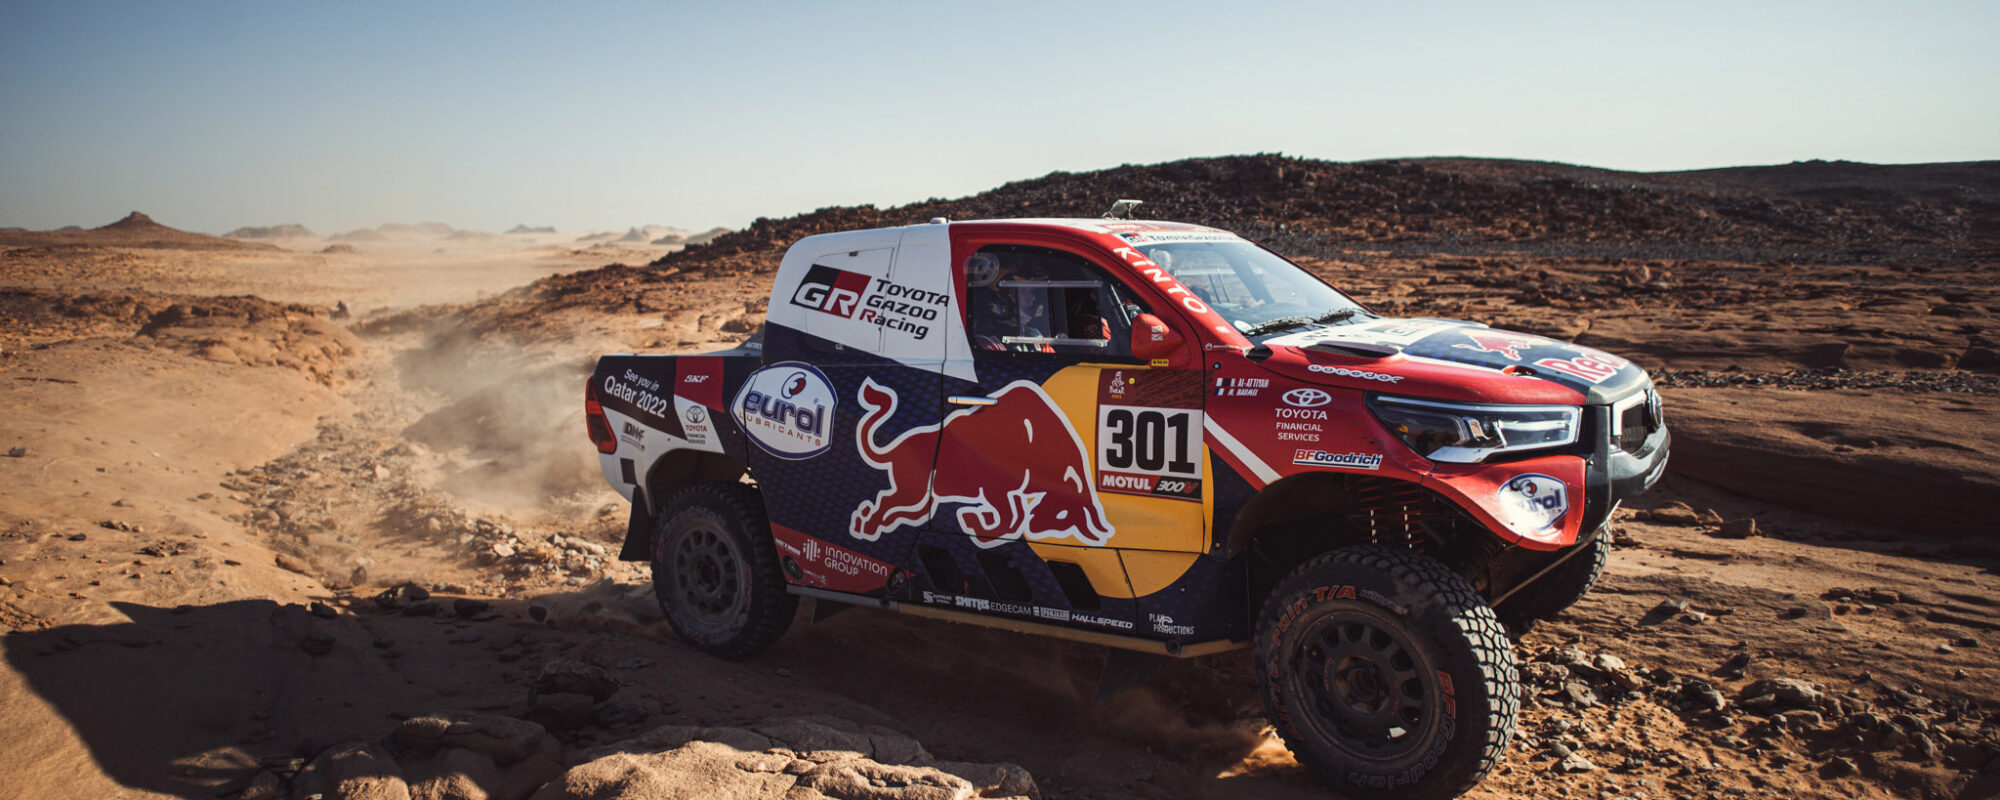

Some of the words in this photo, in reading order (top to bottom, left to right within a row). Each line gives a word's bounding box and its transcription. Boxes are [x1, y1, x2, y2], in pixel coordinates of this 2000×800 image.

[1113, 247, 1207, 313] KINTO
[794, 281, 860, 317] GR
[876, 278, 951, 307] TOYOTA
[865, 294, 938, 321] GAZOO
[858, 308, 929, 340] Racing
[623, 368, 639, 382] See
[638, 376, 650, 388] you
[650, 380, 660, 392] in
[684, 375, 709, 383] SKF
[604, 375, 637, 404] Qatar
[636, 390, 667, 418] 2022
[743, 390, 825, 438] eurol
[1275, 408, 1328, 420] TOYOTA
[686, 424, 708, 432] TOYOTA
[738, 411, 822, 447] LUBRICANTS
[1276, 422, 1323, 432] FINANCIAL
[1277, 432, 1320, 442] SERVICES
[1106, 409, 1195, 474] 301
[1294, 449, 1382, 465] BFGoodrich
[1102, 475, 1152, 491] MOTUL
[1156, 480, 1199, 494] 300V
[824, 557, 860, 576] GROUP
[825, 546, 888, 577] INNOVATION
[1313, 584, 1356, 601] T/A
[990, 601, 1032, 616] EDGECAM
[1071, 613, 1134, 629] HALLSPEED
